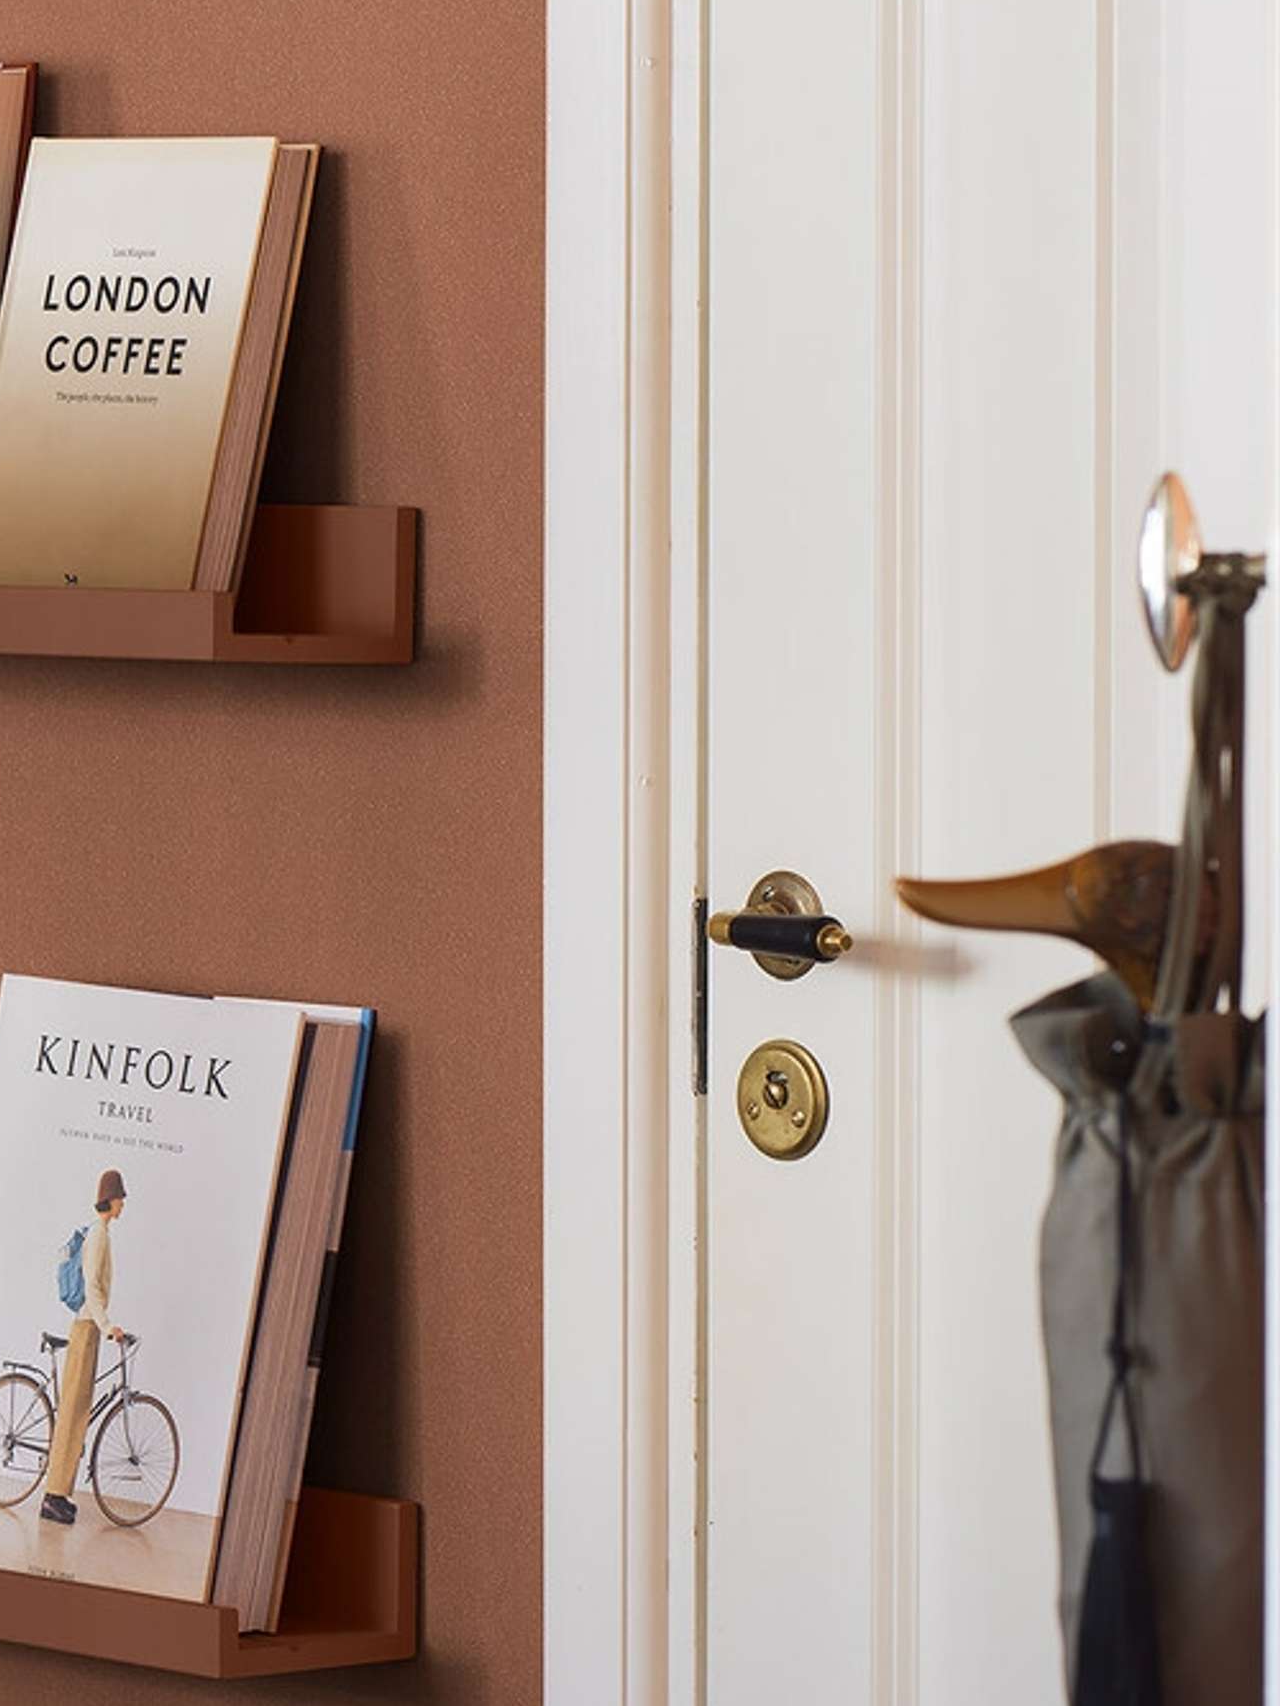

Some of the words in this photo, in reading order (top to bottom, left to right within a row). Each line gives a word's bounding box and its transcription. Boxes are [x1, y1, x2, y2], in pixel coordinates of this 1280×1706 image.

[43, 274, 212, 314] LONDON
[45, 335, 188, 376] COFFEE
[35, 1034, 233, 1100] KINFOLK
[98, 1101, 154, 1124] TRAVEL
